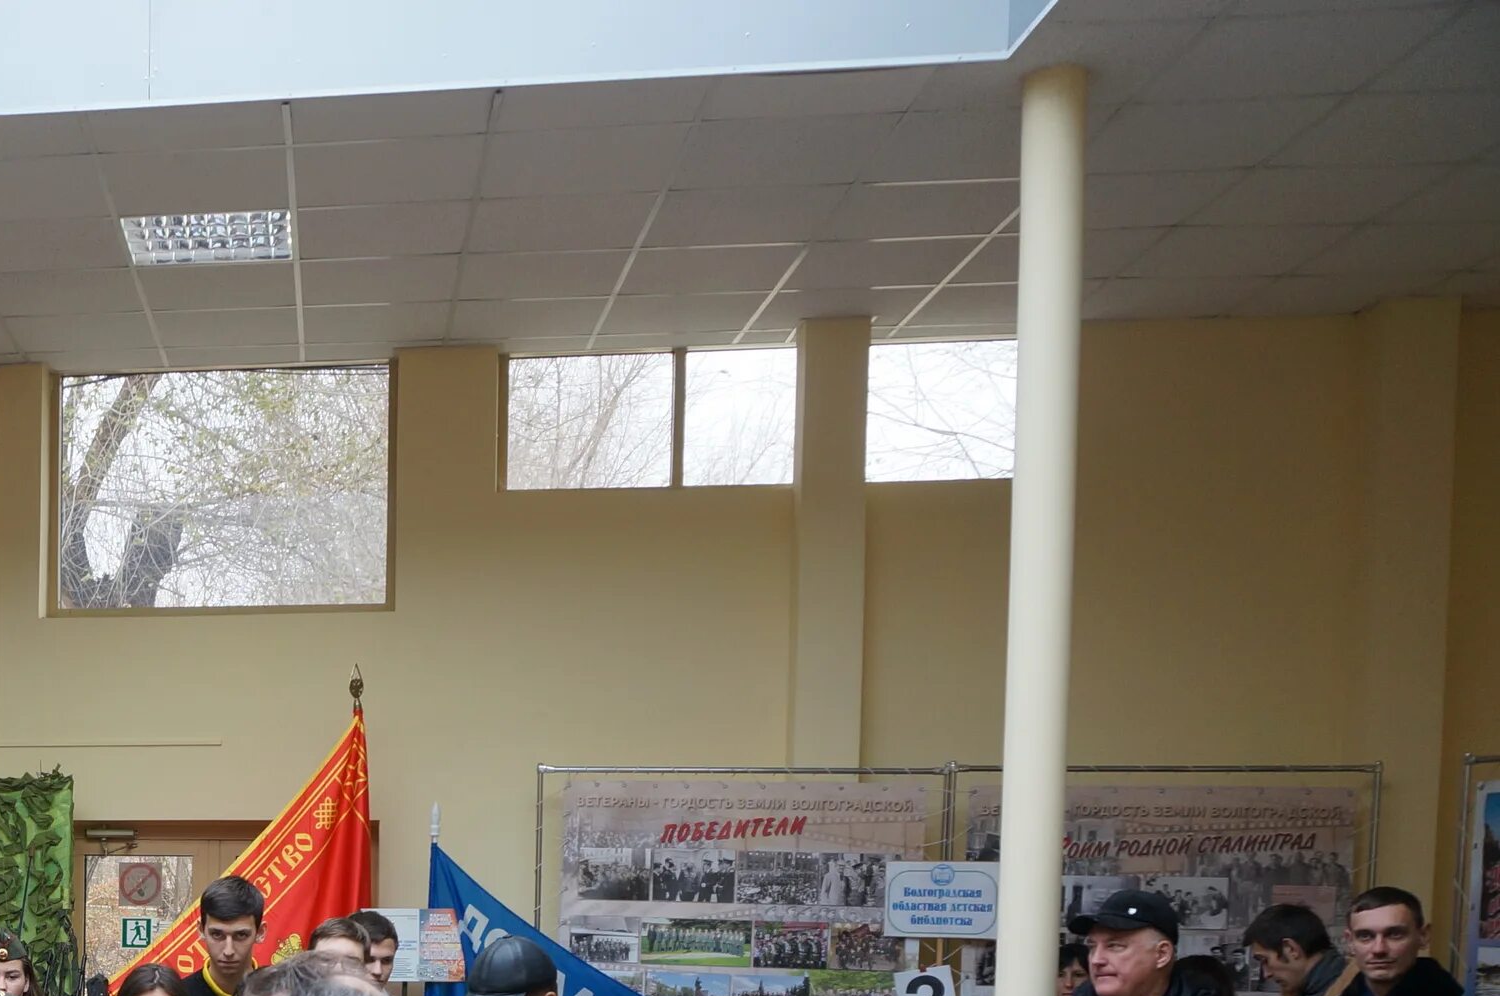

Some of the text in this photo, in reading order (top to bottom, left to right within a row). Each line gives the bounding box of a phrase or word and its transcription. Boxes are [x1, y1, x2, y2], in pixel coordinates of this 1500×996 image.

[576, 797, 650, 809] ВЕТЕРАНЫ
[662, 798, 734, 811] ГОРДОСТЬ
[737, 799, 787, 811] ЗЕМЛИ
[791, 800, 915, 814] ВОЛГОГРАДСКОЙ
[1074, 804, 1343, 820] ГОРДОСТЬ ЗЕМЛИ ВОЛГОГРАДСКОЙ
[660, 815, 808, 844] ПОБЕДИТЕЛИ
[1115, 833, 1194, 857] РОДНОЙ
[1199, 832, 1317, 855] СТАЛИНГРАД
[903, 887, 983, 899] Волгоградская
